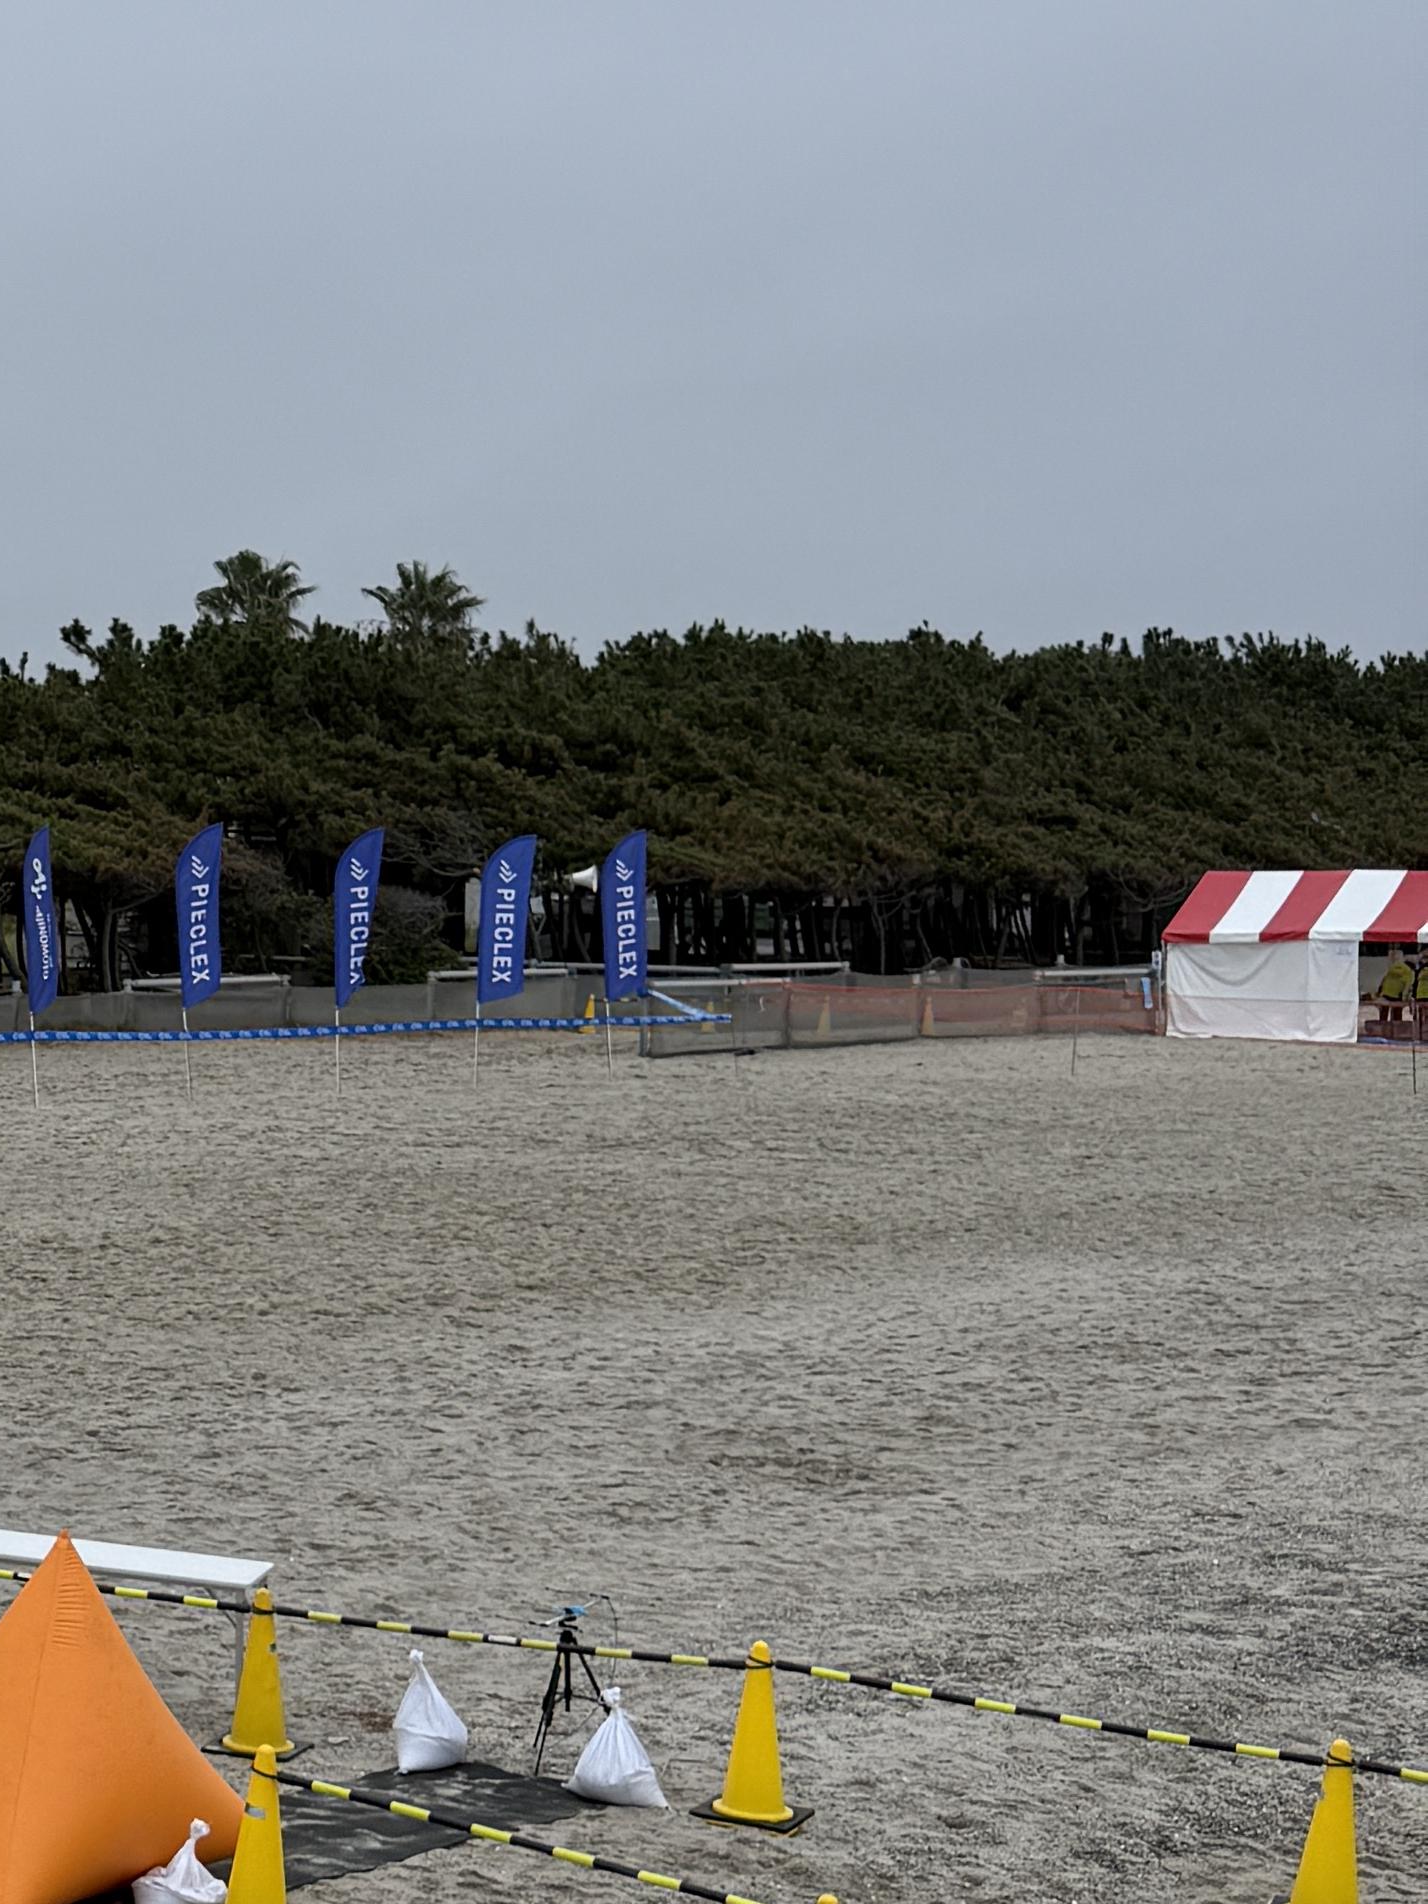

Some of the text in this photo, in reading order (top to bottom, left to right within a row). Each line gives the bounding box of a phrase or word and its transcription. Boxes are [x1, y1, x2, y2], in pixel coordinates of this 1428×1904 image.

[190, 883, 210, 984] PIECLEX
[492, 888, 516, 983] PIECLEX
[616, 885, 637, 979] PIECLEX
